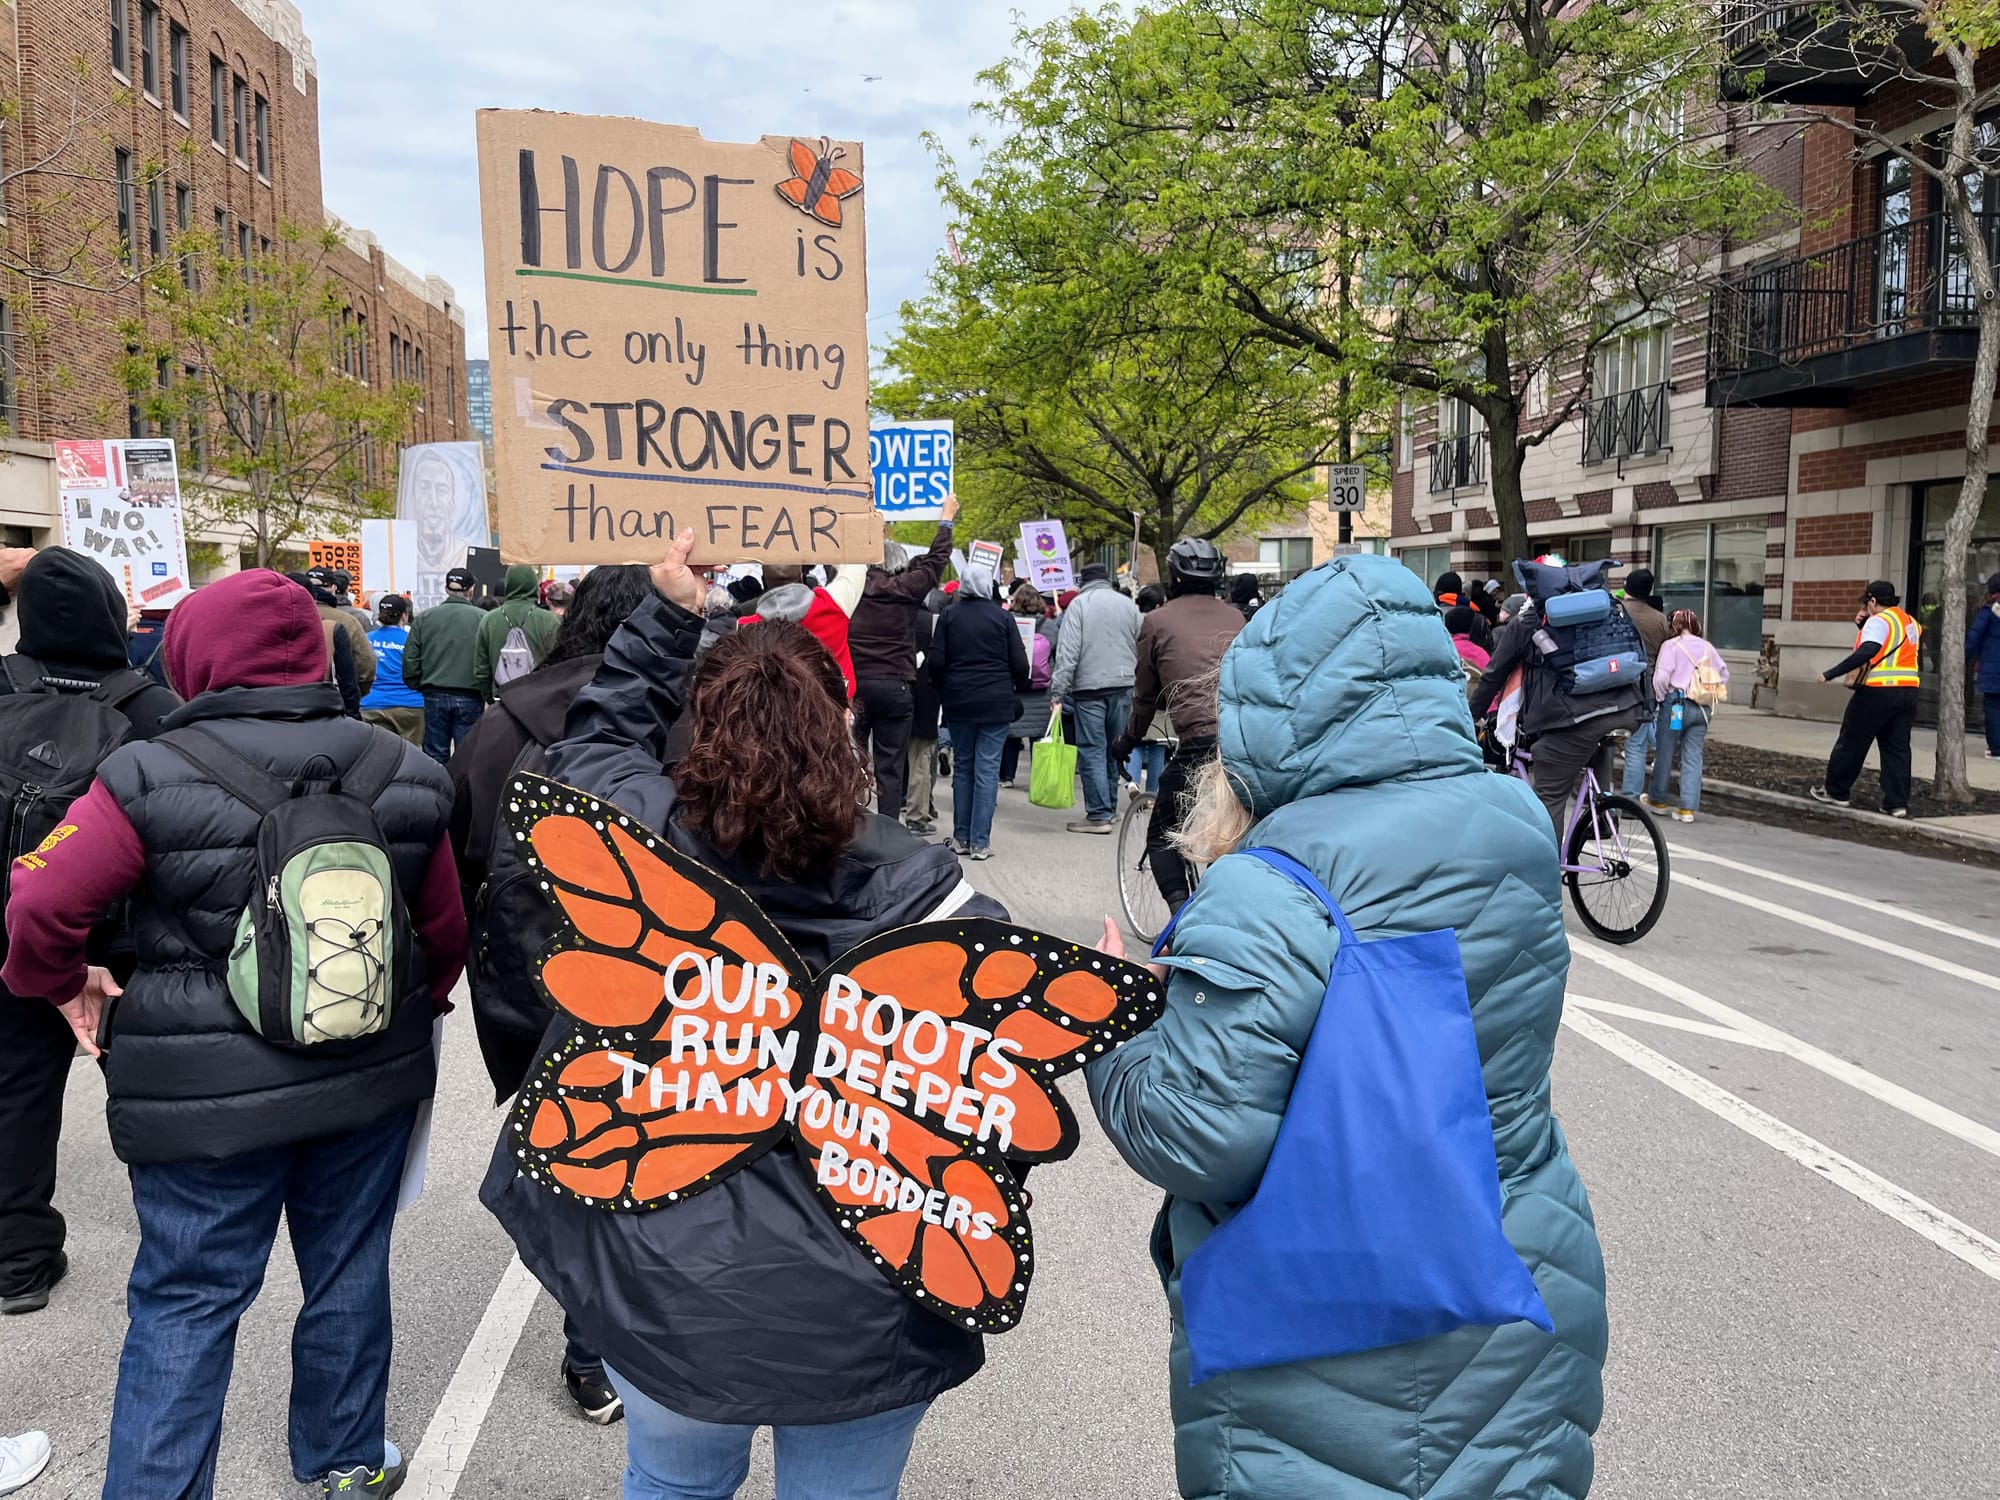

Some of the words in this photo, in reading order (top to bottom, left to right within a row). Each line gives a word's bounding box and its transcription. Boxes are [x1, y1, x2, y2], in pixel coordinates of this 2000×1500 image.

[519, 149, 755, 285] HOPE
[796, 228, 844, 281] is
[499, 300, 592, 359] the
[624, 317, 706, 386] only
[736, 322, 845, 390] thing
[543, 398, 857, 482] STRONGER
[870, 433, 952, 469] OWER
[1333, 467, 1360, 476] SPEED
[873, 471, 949, 505] ICES
[1333, 486, 1359, 506] 30
[1335, 477, 1357, 485] LIMIT
[83, 527, 164, 557] WAR!
[100, 507, 145, 531] NO
[555, 484, 674, 543] than
[706, 505, 841, 553] FEAR
[664, 951, 791, 1019] OUR
[669, 1014, 800, 1074] RUN
[823, 973, 1024, 1089] ROOTS
[607, 1052, 784, 1118] THAN
[777, 1076, 891, 1155] YOUR
[812, 1033, 1016, 1152] DEEPER
[817, 1142, 998, 1241] BORDERS
